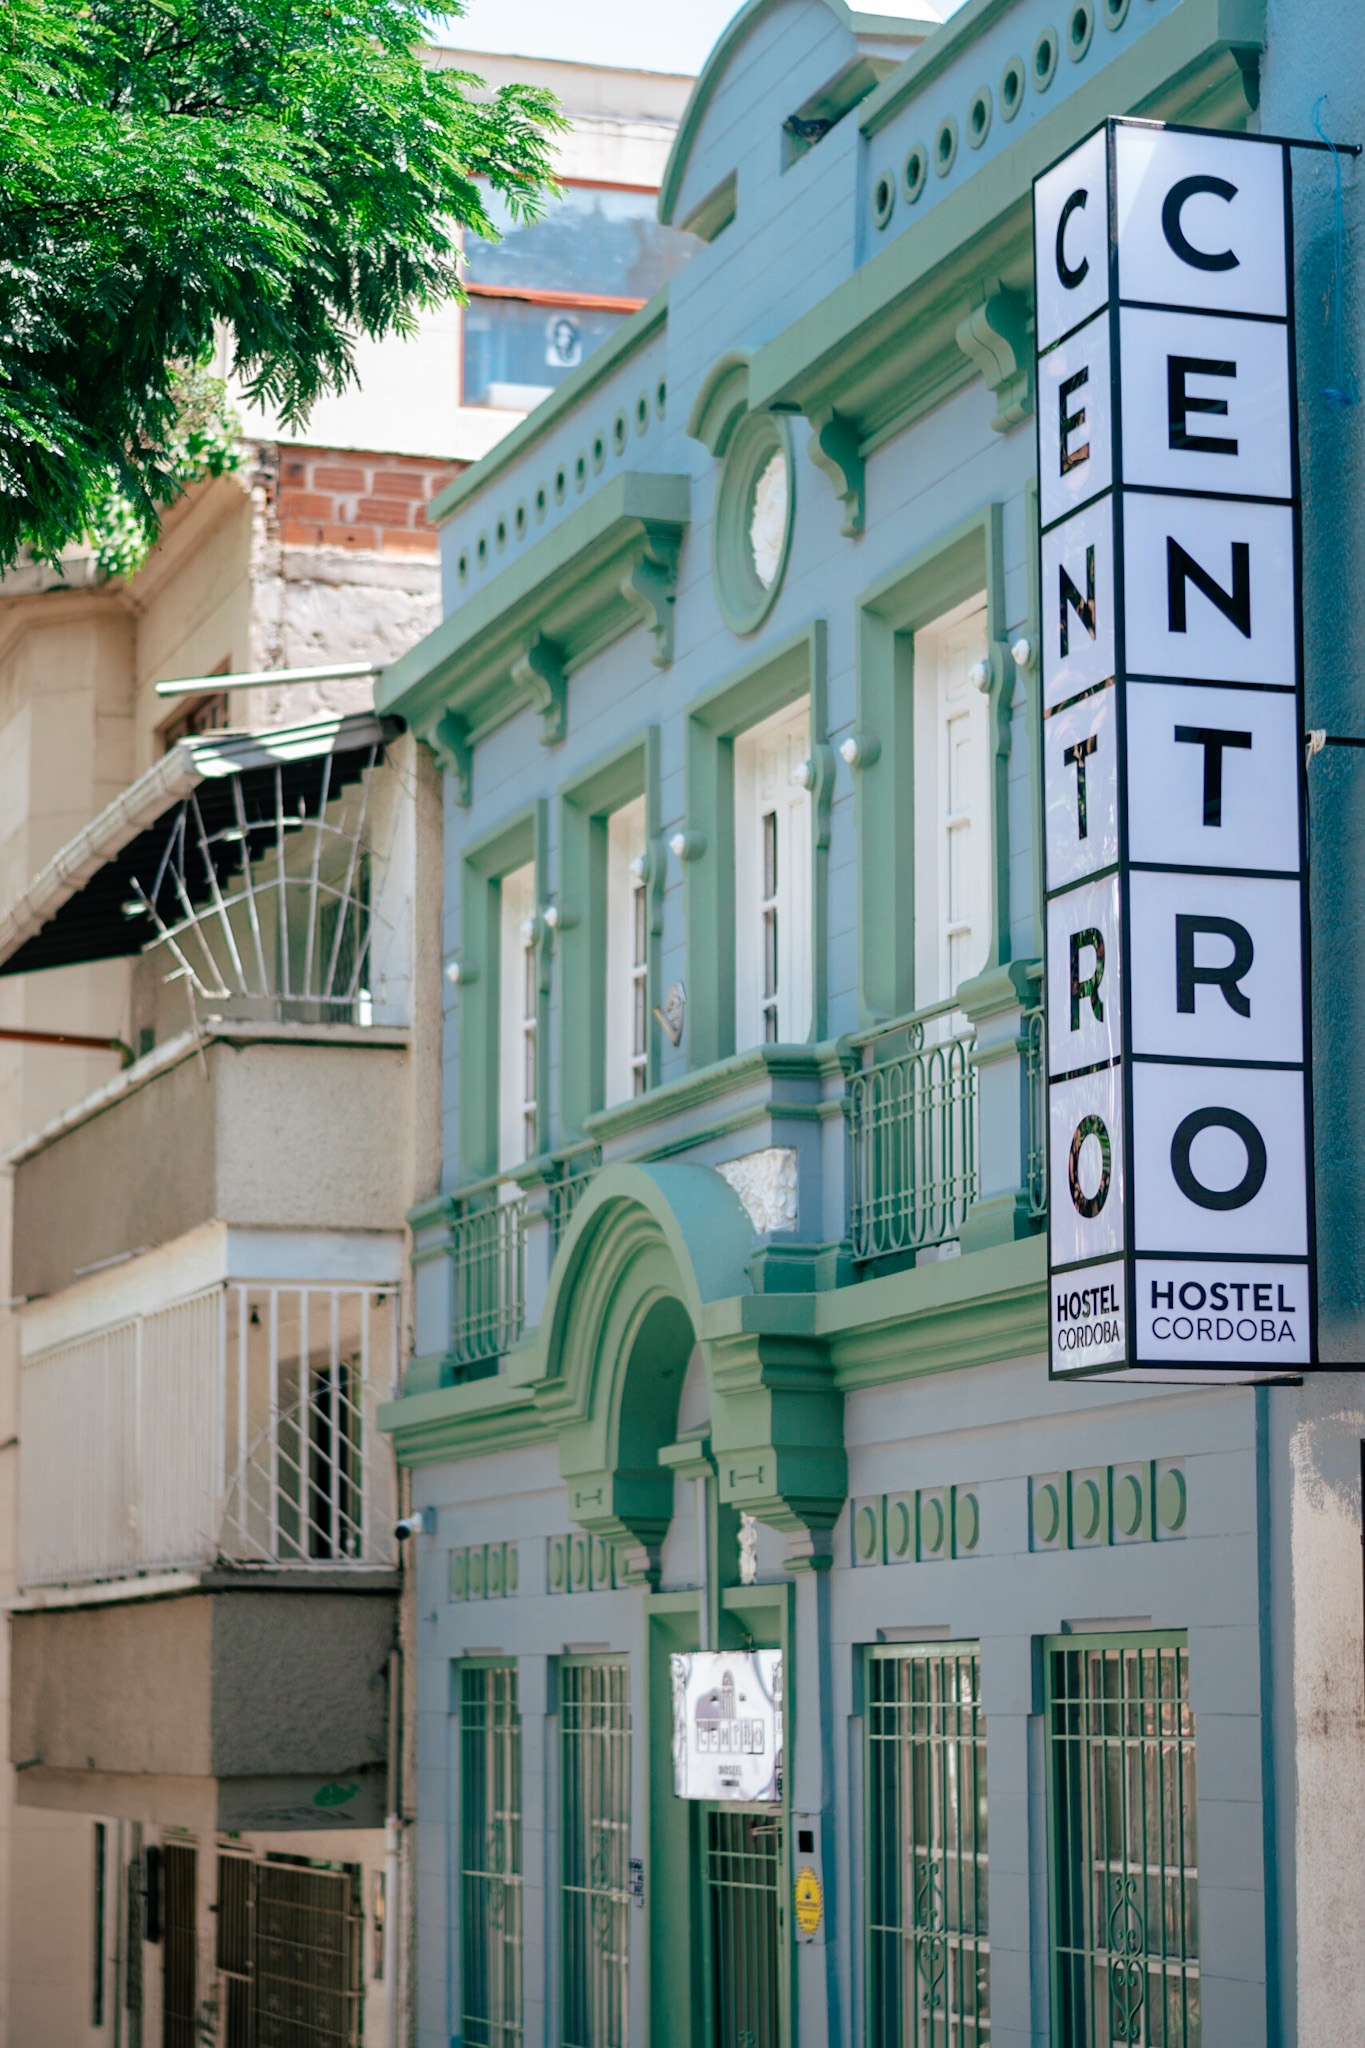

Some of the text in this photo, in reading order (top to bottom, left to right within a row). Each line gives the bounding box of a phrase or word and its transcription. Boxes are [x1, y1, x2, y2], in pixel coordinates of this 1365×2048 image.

[1056, 188, 1111, 1218] CENTRO
[1161, 175, 1267, 1211] CENTRO
[1057, 1283, 1119, 1322] HOSTEL
[1151, 1280, 1295, 1312] HOSTEL
[1058, 1320, 1120, 1351] CORDOBA
[1152, 1316, 1296, 1342] CORDOBA
